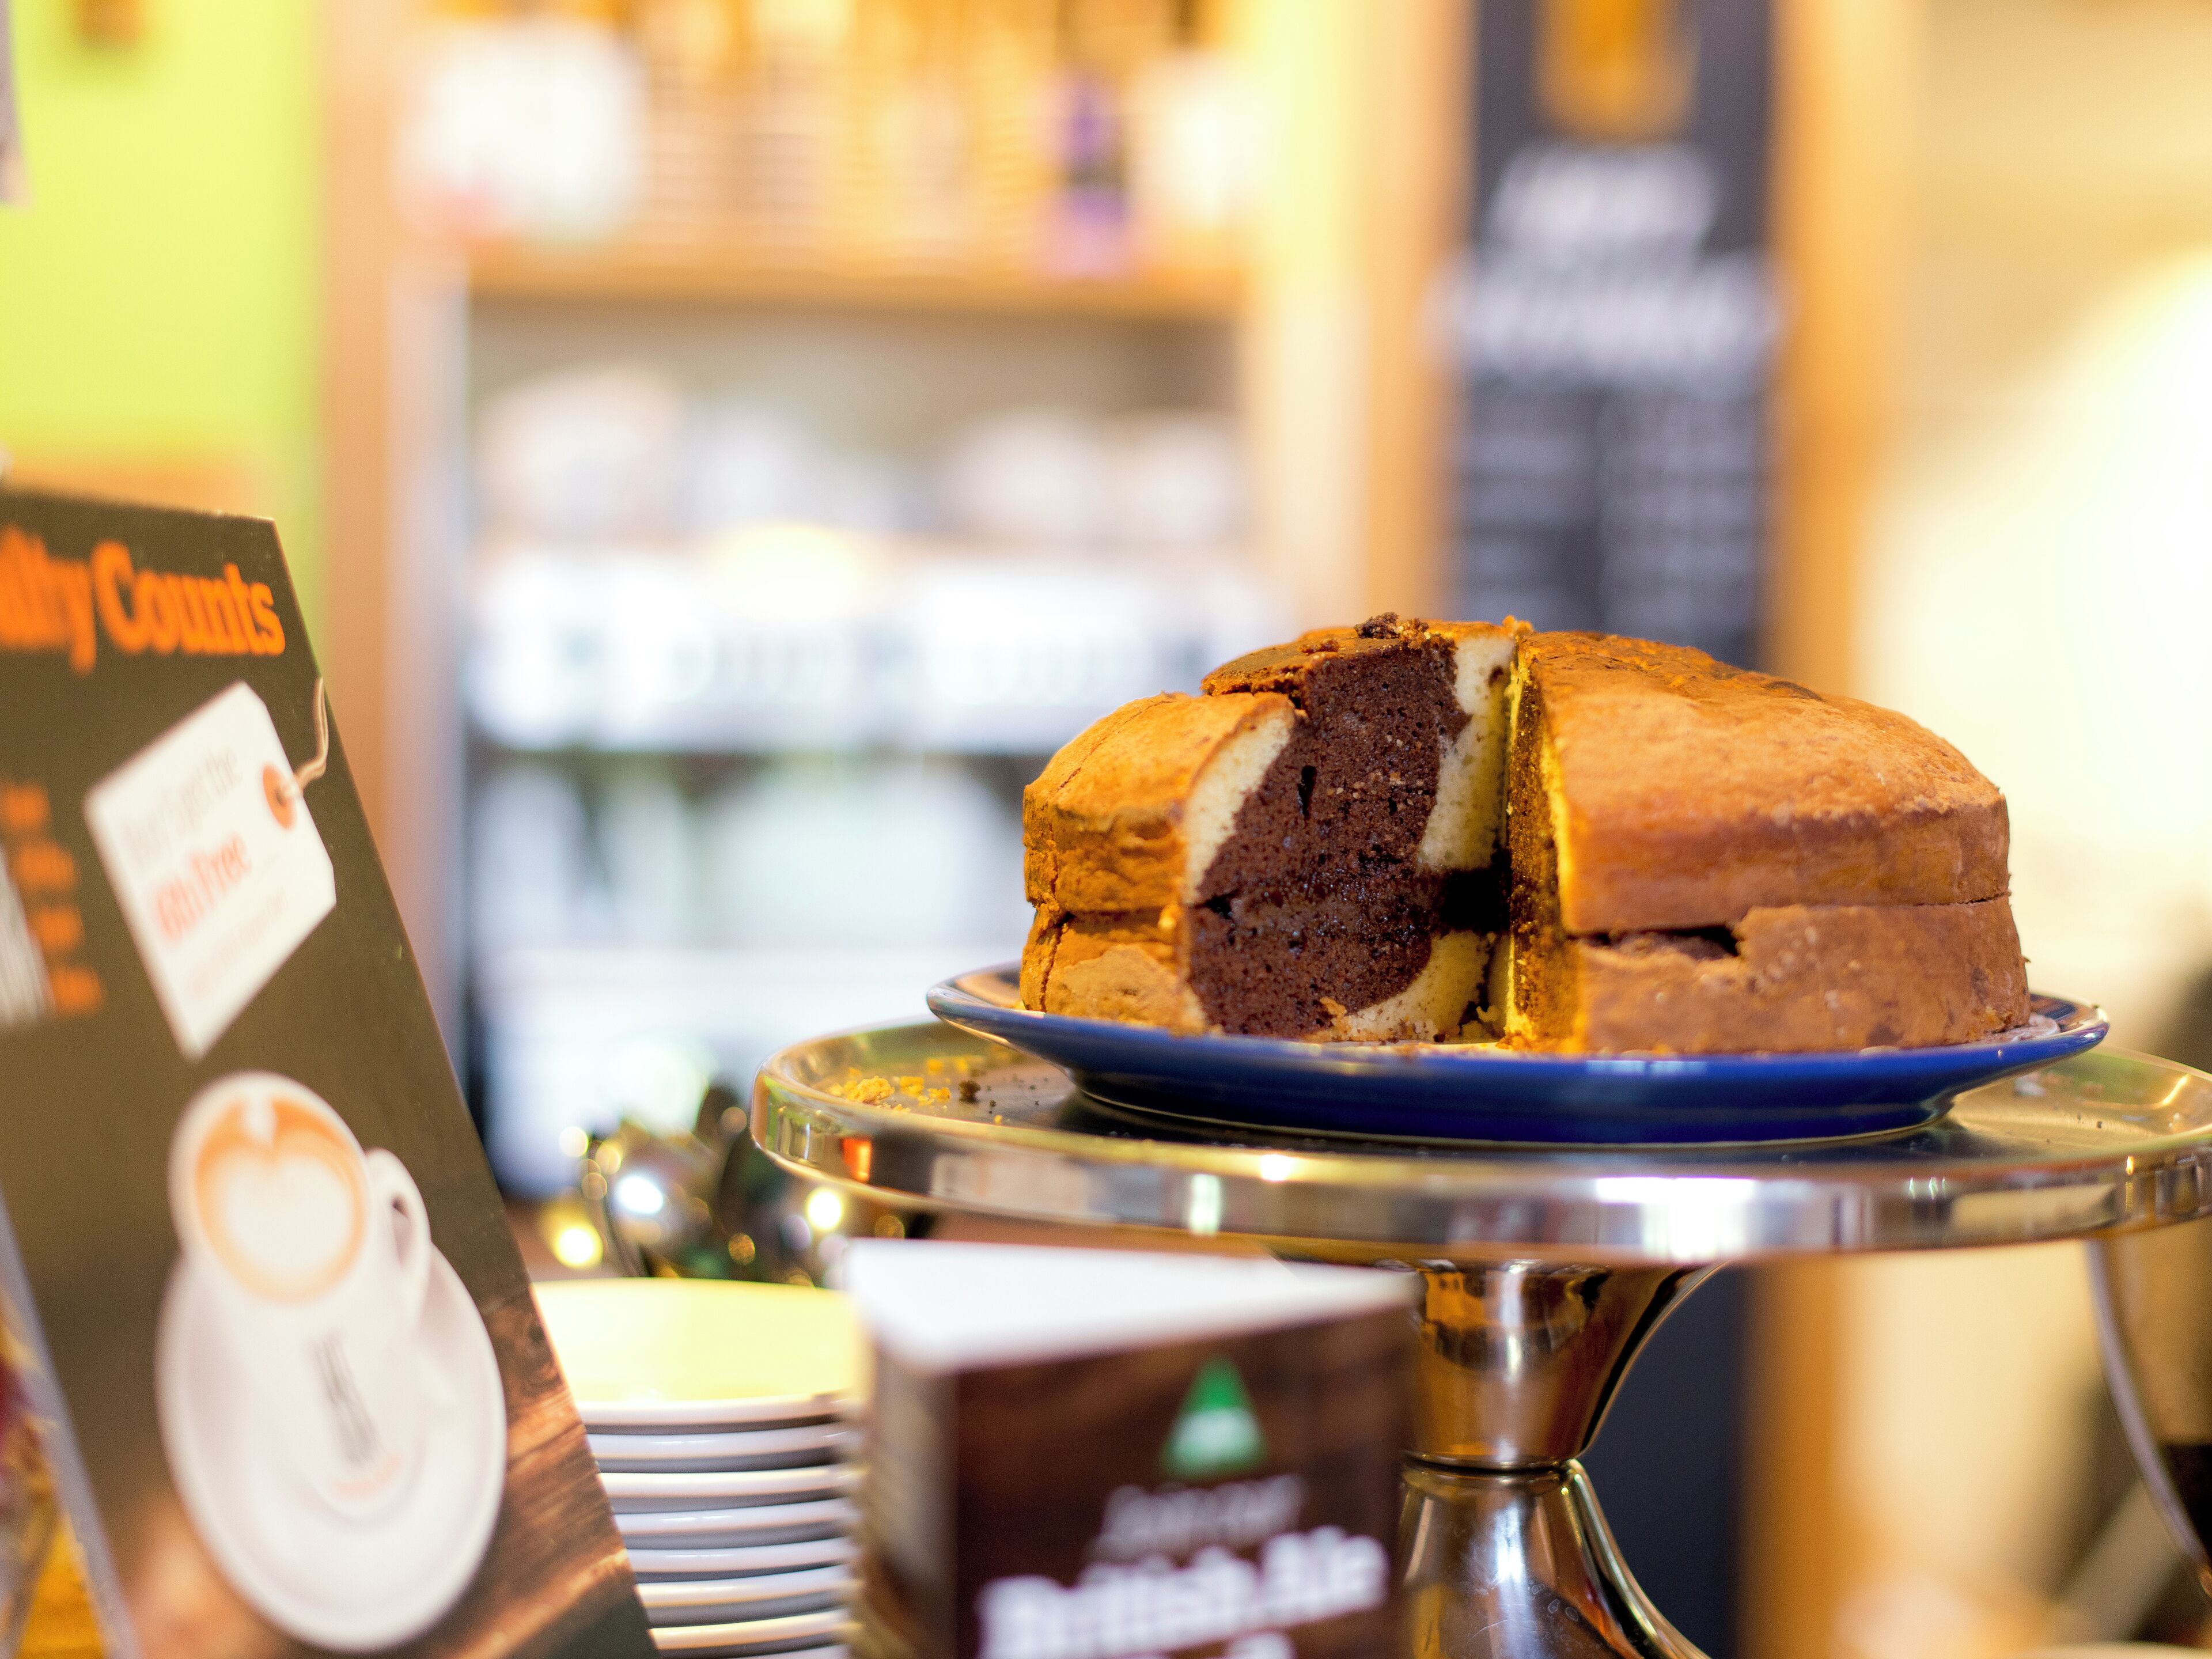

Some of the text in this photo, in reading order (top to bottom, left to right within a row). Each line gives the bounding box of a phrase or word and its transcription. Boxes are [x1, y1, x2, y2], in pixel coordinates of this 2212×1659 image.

[91, 540, 285, 656] Counts
[203, 748, 243, 801] the
[188, 831, 253, 911] Free
[976, 1525, 1388, 1659] British Ale
